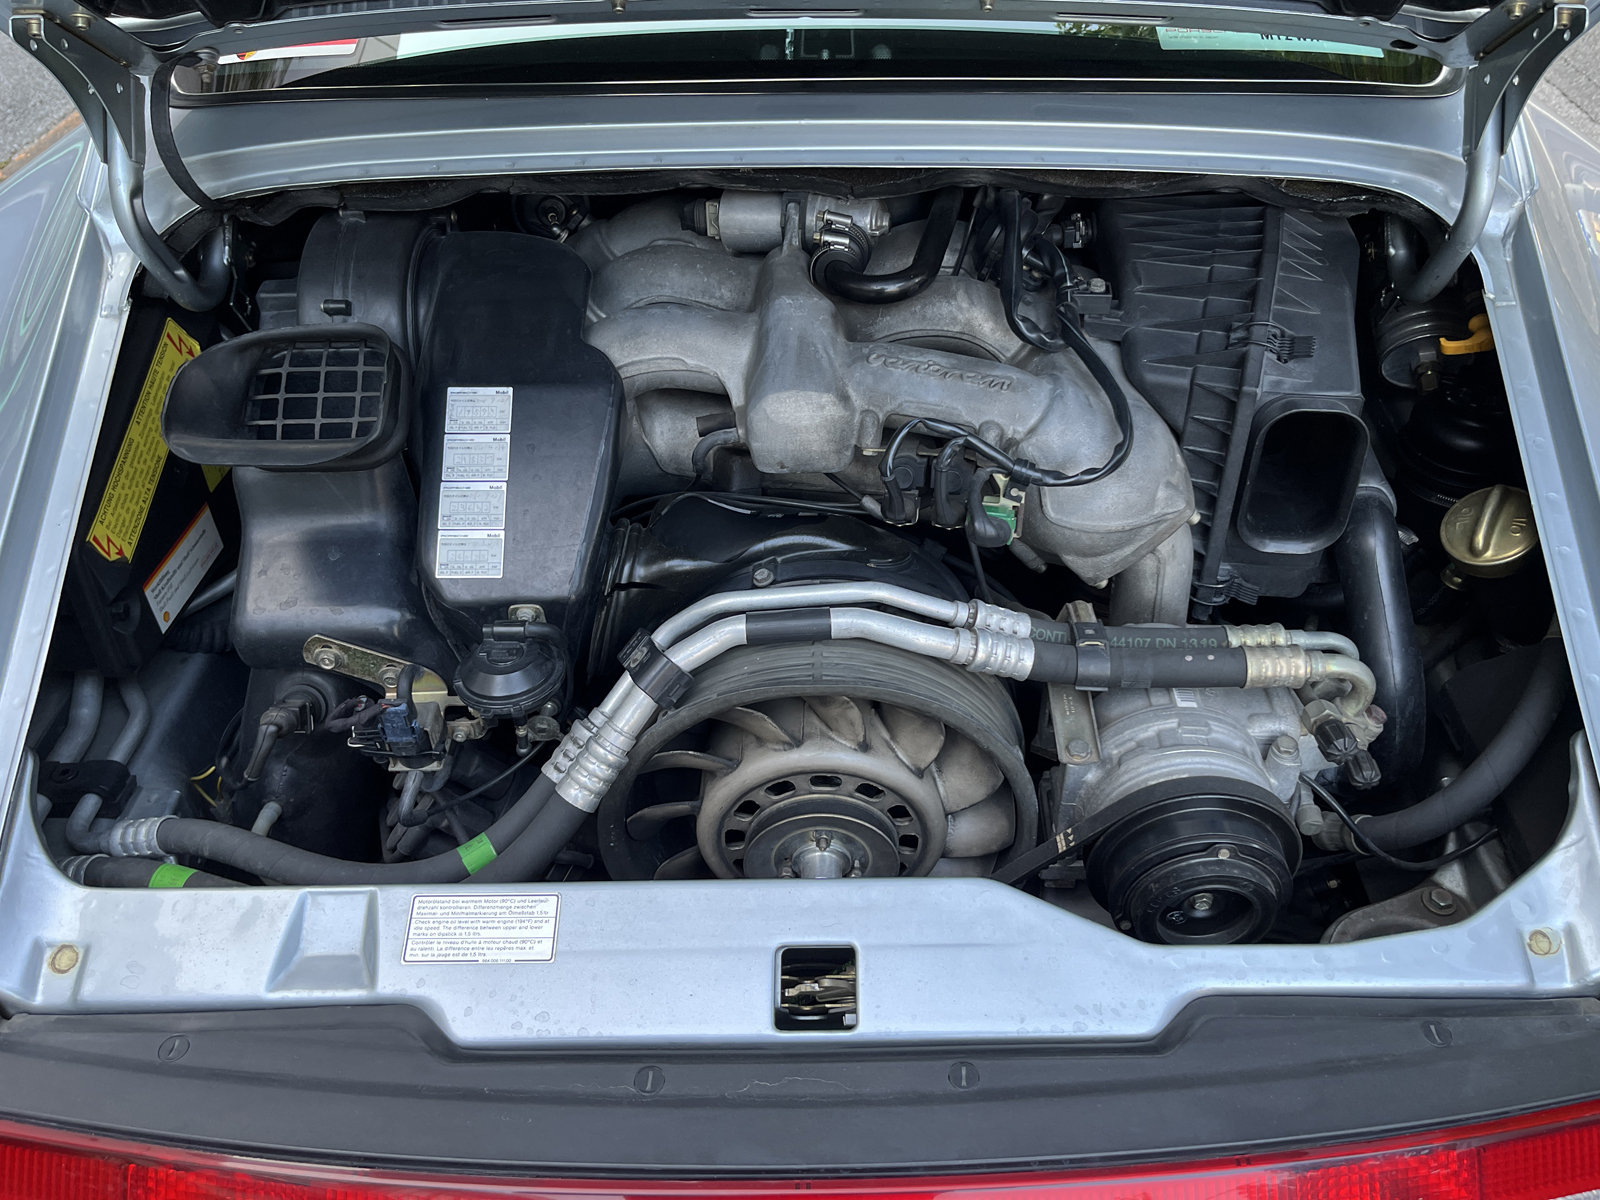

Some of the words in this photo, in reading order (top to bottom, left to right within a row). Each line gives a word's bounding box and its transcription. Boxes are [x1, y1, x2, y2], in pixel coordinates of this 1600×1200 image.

[135, 388, 151, 426] ATTENTION
[148, 367, 159, 390] HAUTE
[155, 341, 168, 368] TENSION
[98, 491, 114, 526] ACHTUNG
[111, 436, 134, 492] HOCHSPANNUNG
[127, 504, 145, 547] ATTENZIONE
[141, 486, 151, 505] ALTA
[148, 453, 162, 486] TENSIONE
[1155, 637, 1177, 649] DN
